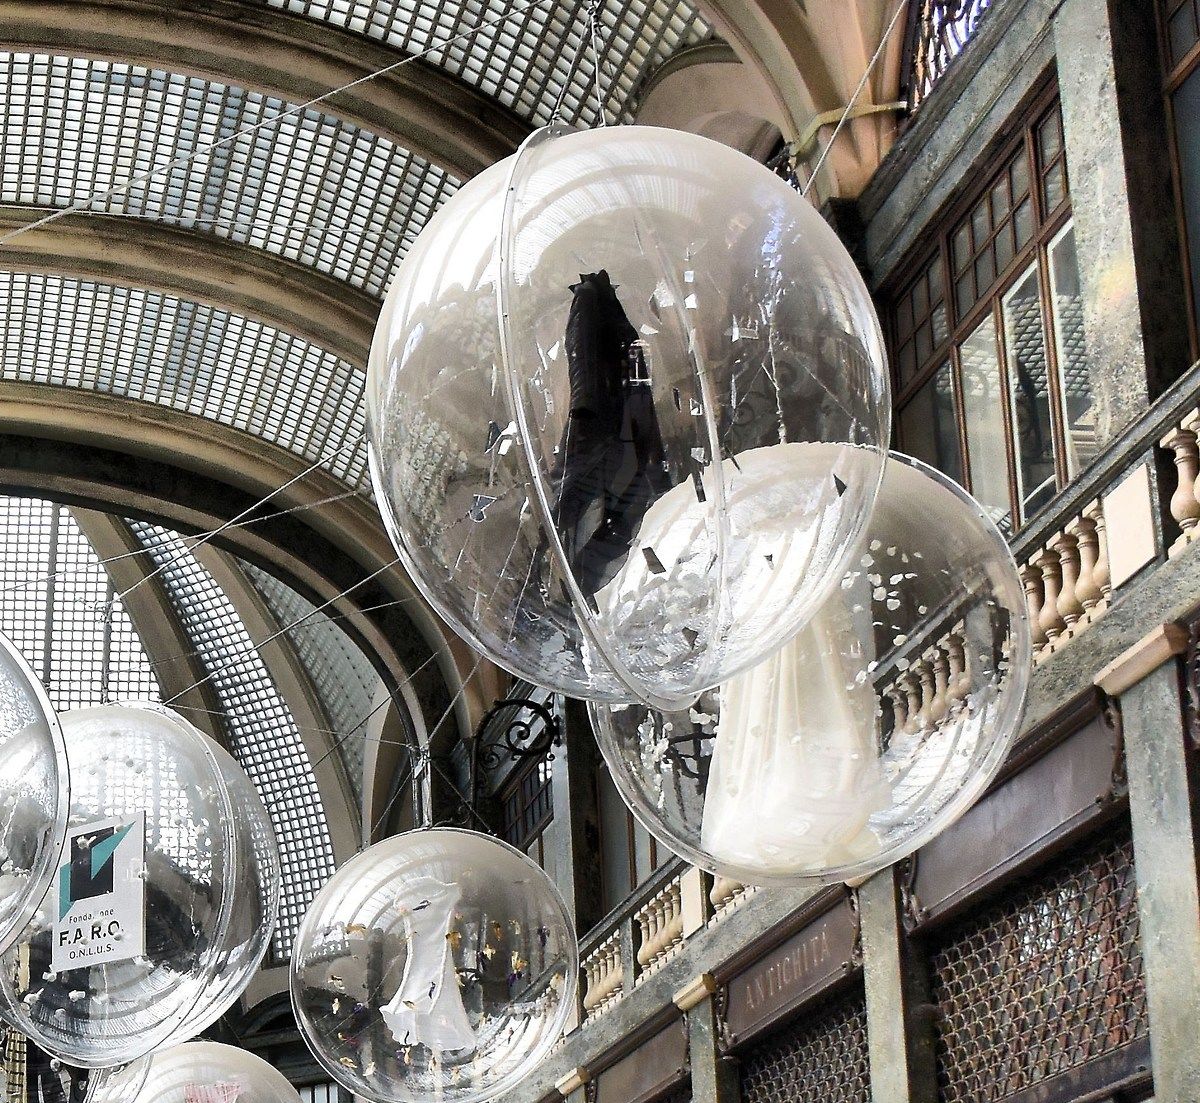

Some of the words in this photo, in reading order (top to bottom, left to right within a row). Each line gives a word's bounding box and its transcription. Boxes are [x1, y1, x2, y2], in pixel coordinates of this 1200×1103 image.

[69, 908, 114, 924] Fondaone
[59, 920, 124, 947] F.AR.O.
[69, 943, 115, 960] O.N.L.U.S.
